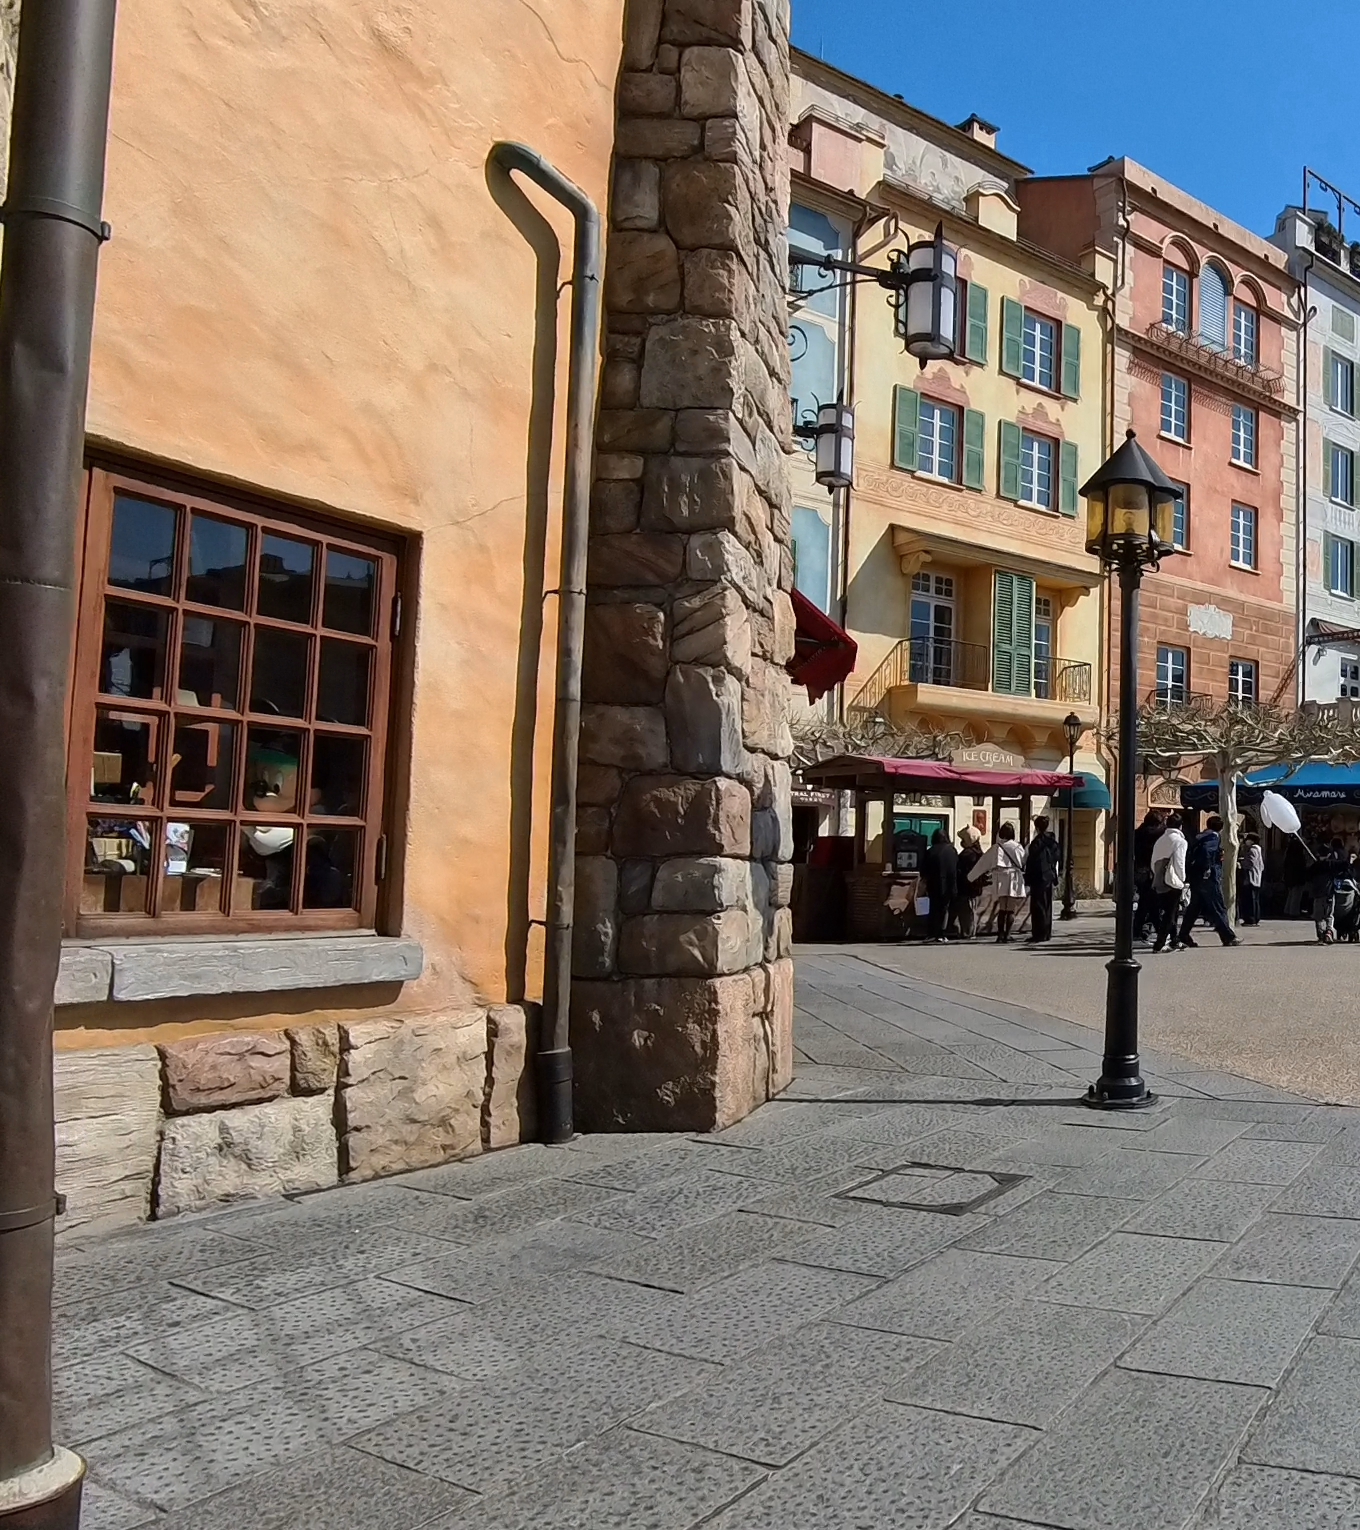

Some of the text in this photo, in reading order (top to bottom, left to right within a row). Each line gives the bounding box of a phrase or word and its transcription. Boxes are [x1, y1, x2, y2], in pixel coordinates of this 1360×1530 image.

[963, 751, 1013, 767] ICE CREAM
[1293, 789, 1346, 798] Miramare
